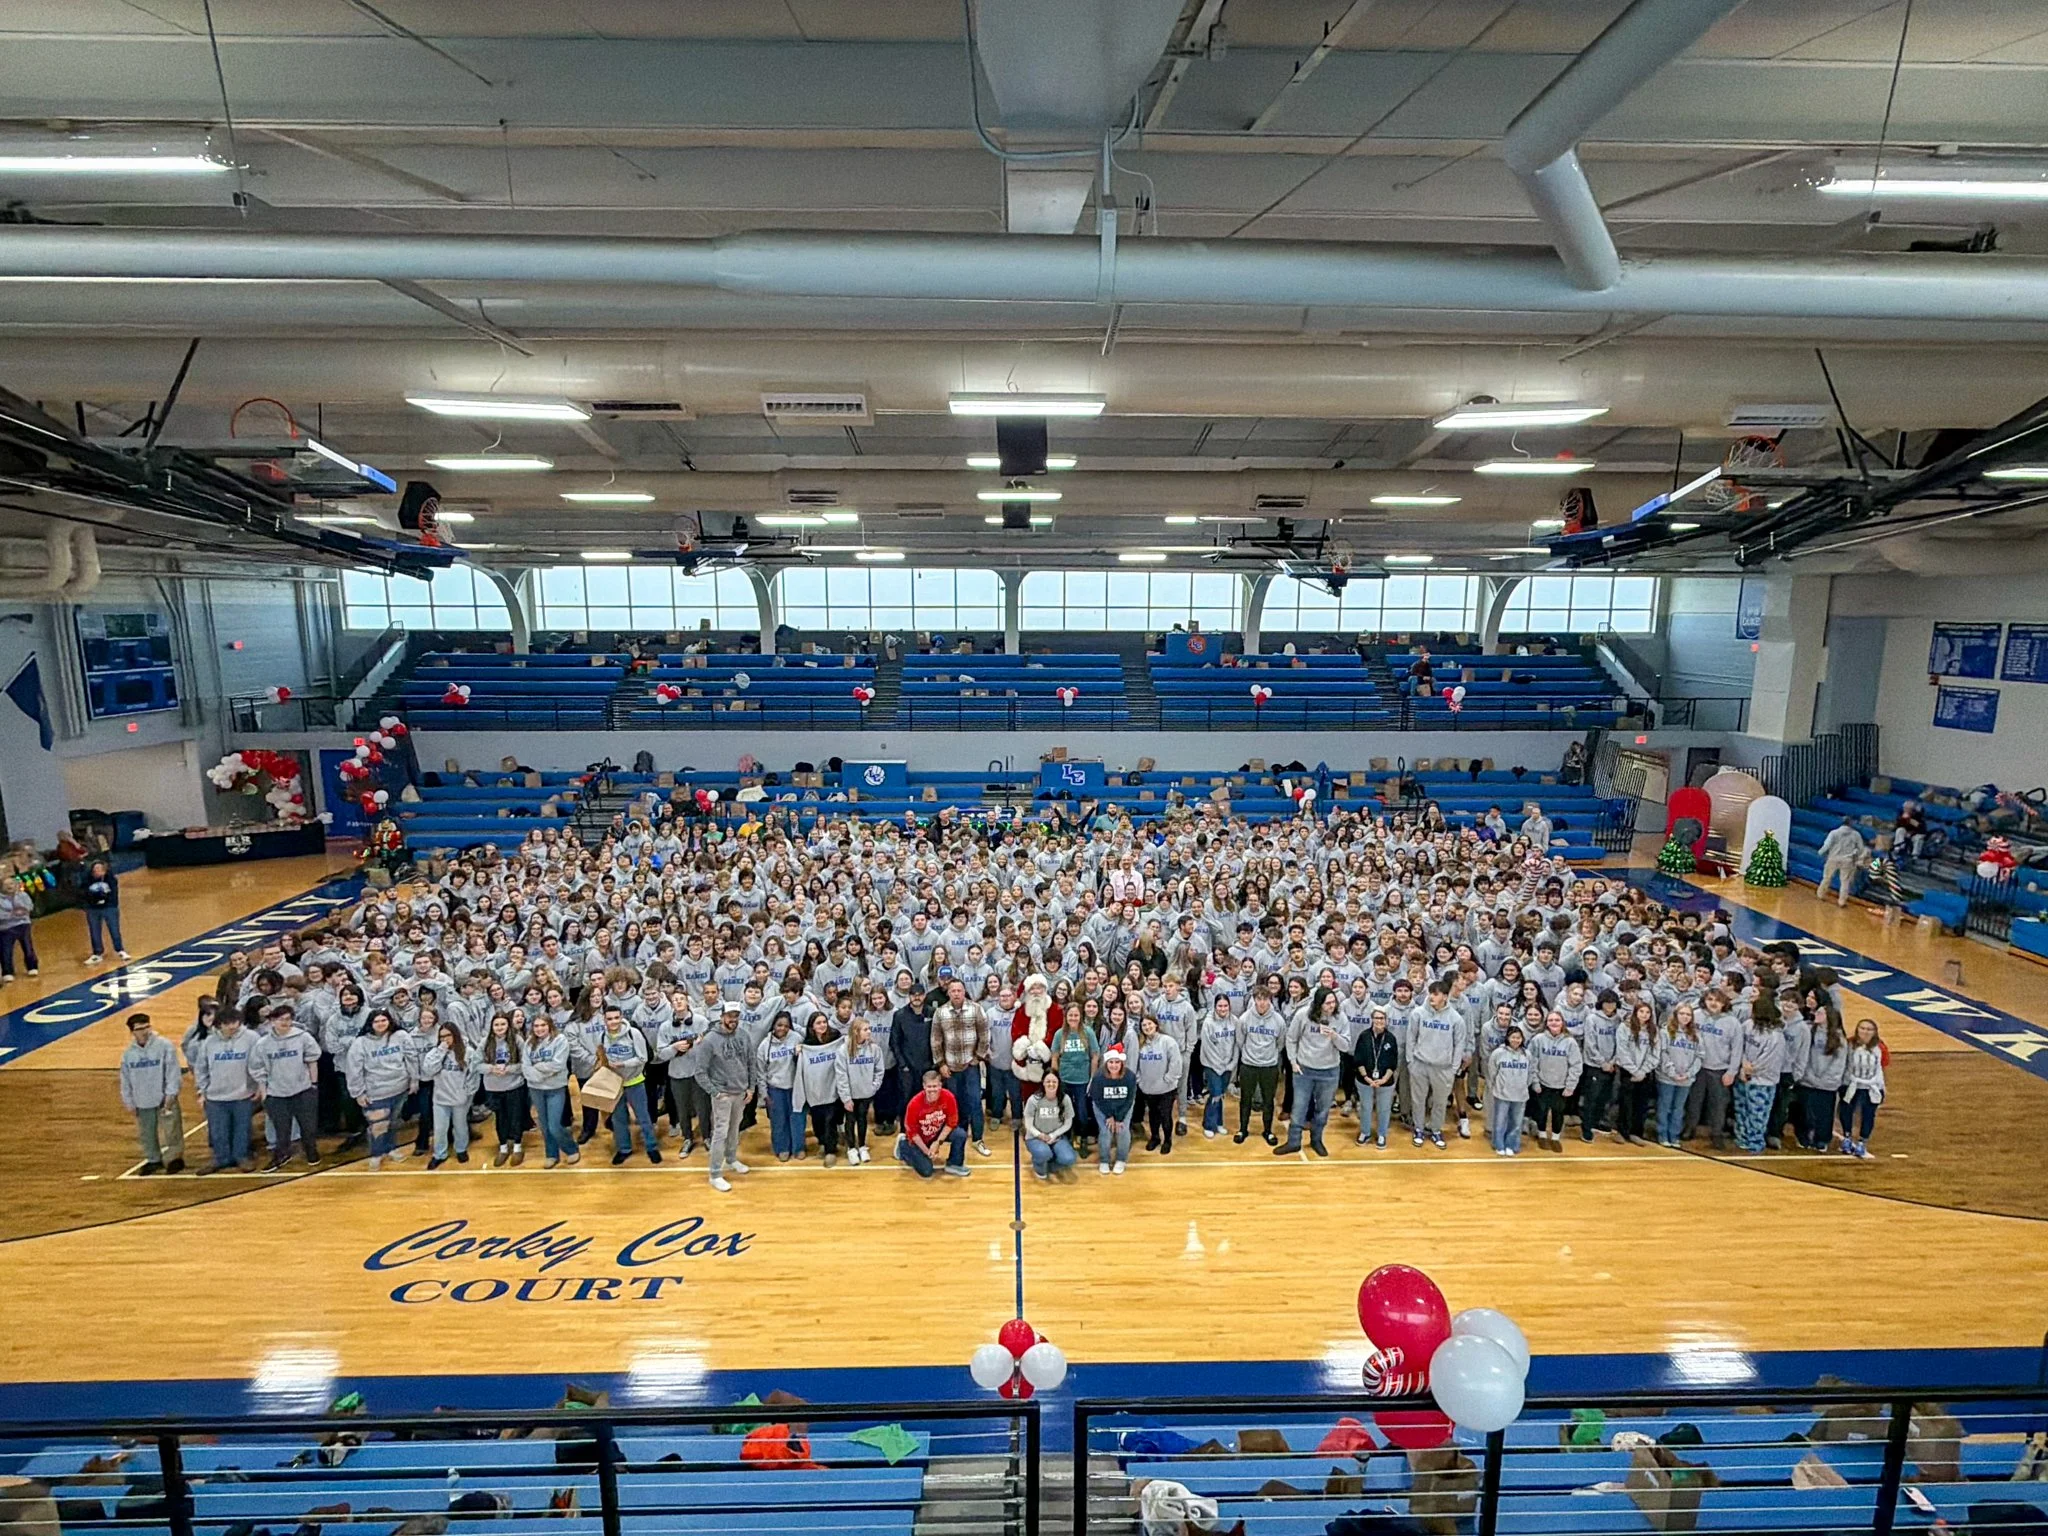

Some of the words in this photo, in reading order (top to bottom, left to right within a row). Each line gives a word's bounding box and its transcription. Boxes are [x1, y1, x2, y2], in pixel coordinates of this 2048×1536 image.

[24, 894, 353, 1024] COUNTY
[809, 1053, 837, 1065] HAWKS
[363, 1219, 595, 1272] Corky
[616, 1216, 757, 1267] Cox
[389, 1276, 684, 1304] COURT
